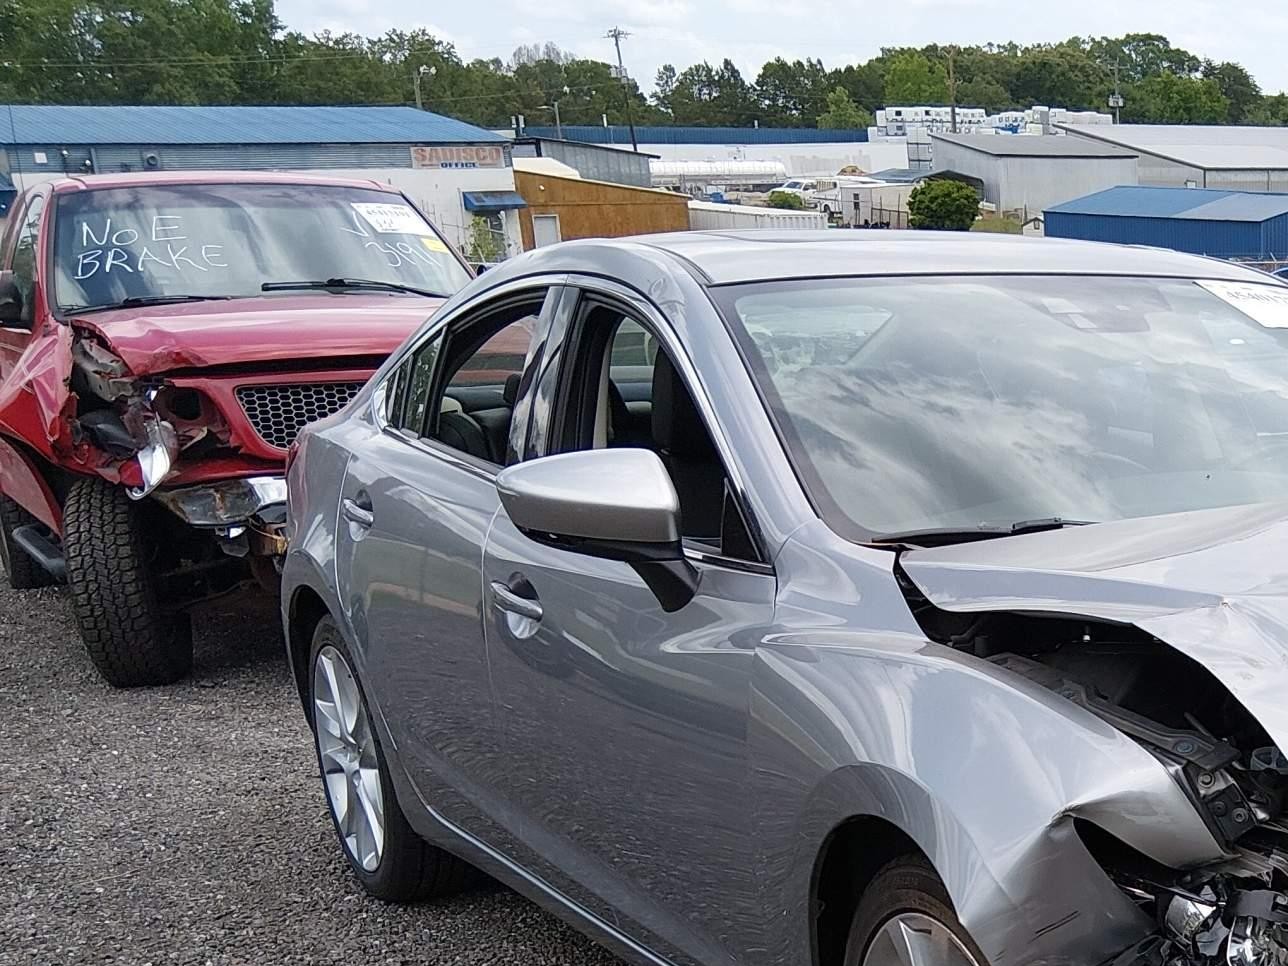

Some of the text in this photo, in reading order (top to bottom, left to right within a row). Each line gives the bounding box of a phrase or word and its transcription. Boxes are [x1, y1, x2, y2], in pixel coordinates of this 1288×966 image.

[414, 147, 501, 162] SADISCO
[152, 215, 187, 241] E
[74, 244, 228, 279] BRAKE
